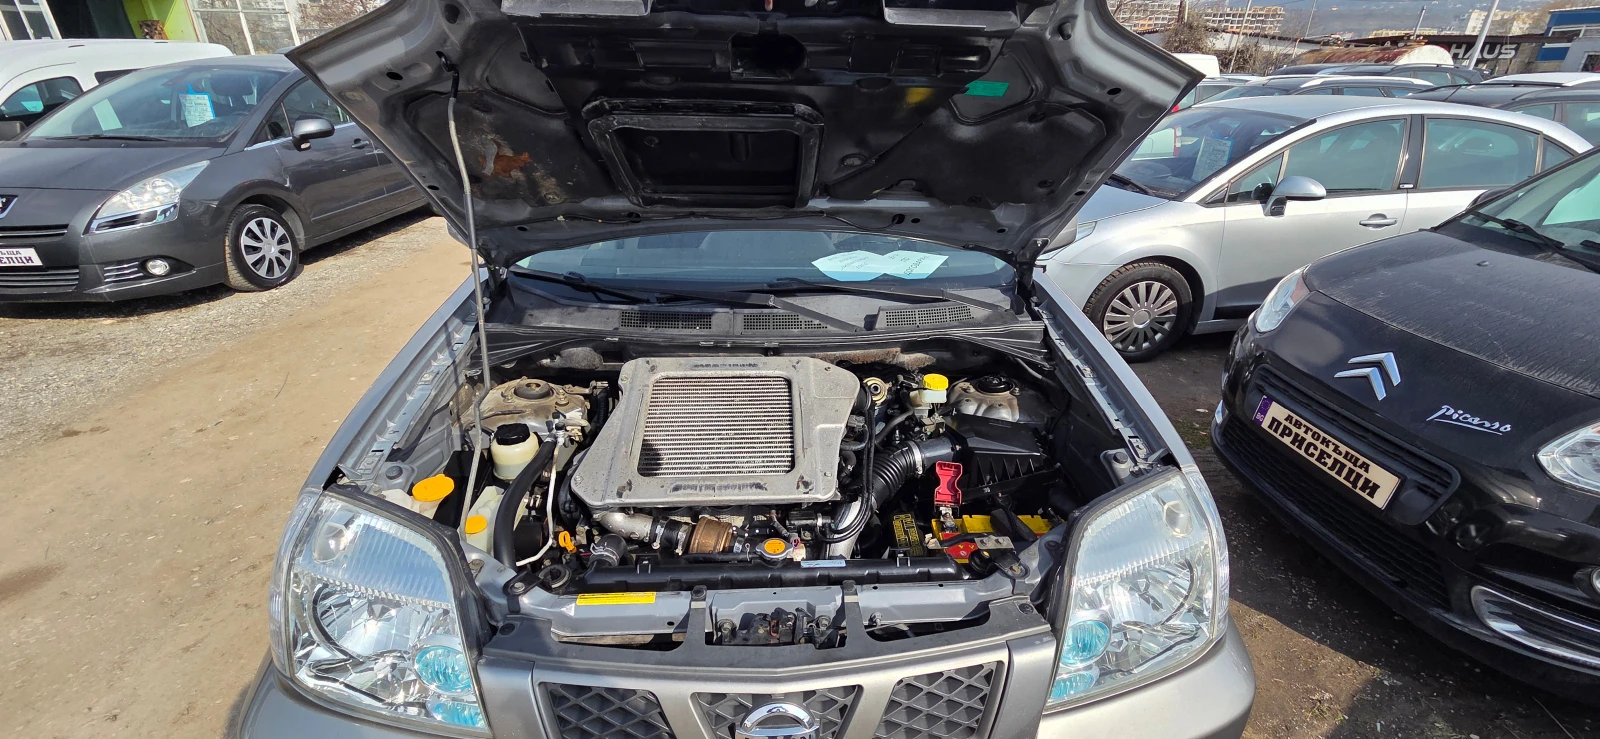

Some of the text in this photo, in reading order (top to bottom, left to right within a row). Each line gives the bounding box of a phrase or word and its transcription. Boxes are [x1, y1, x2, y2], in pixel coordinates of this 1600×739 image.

[1255, 413, 1264, 422] BG
[1284, 414, 1371, 474] АВТОКЪЩА
[1267, 416, 1381, 499] ПРИСЕЛЦИ
